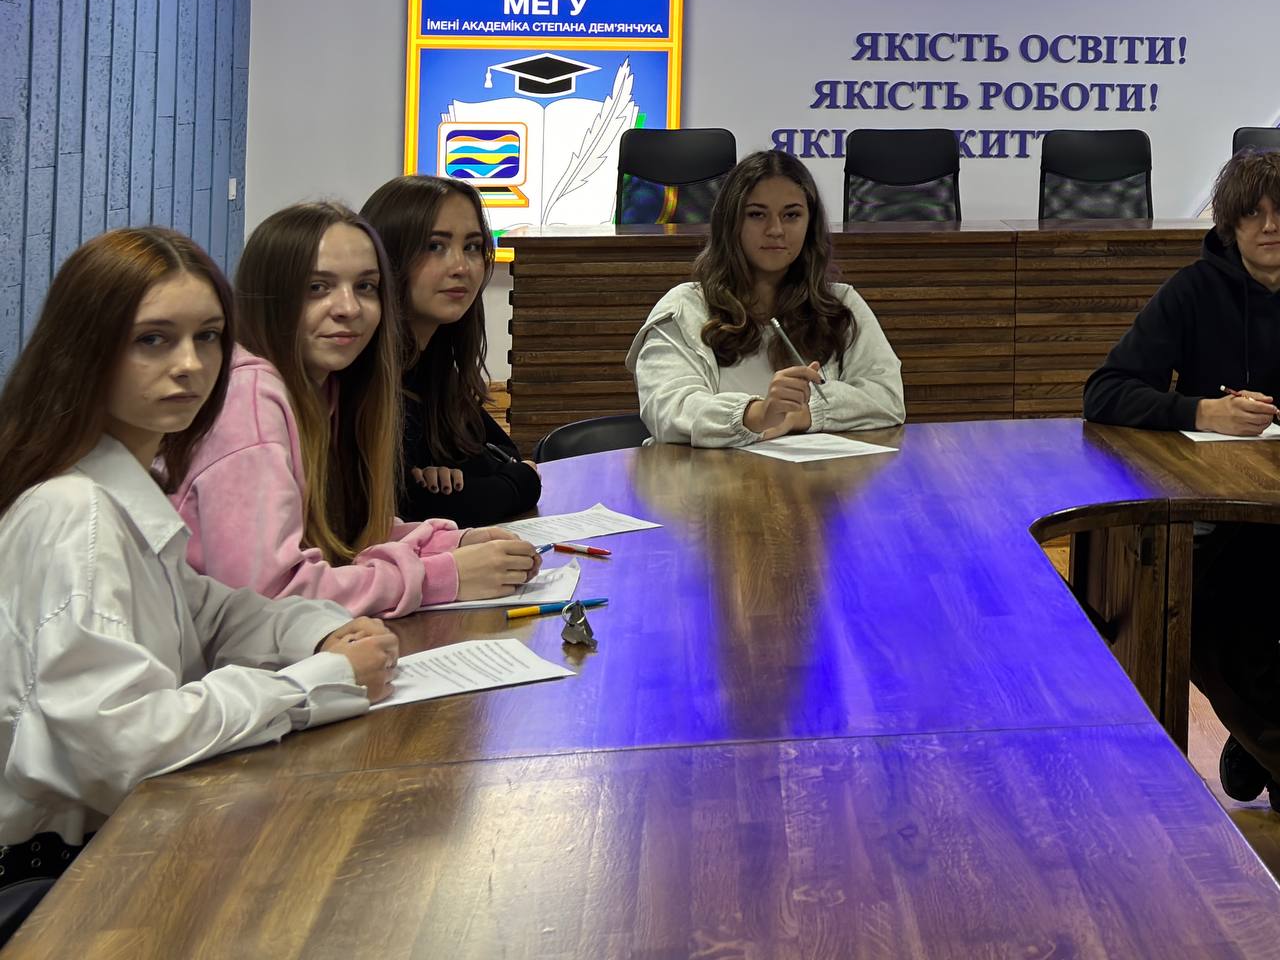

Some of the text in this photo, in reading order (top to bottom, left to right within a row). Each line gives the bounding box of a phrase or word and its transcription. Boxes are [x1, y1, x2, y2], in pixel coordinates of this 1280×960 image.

[532, 22, 586, 33] СТЕПАНА
[851, 32, 1188, 65] ЯКІСТЬ ОСВІТИ!
[809, 80, 1159, 112] ЯКІСТЬ РОБОТИ!
[770, 128, 848, 159] ЯКІ
